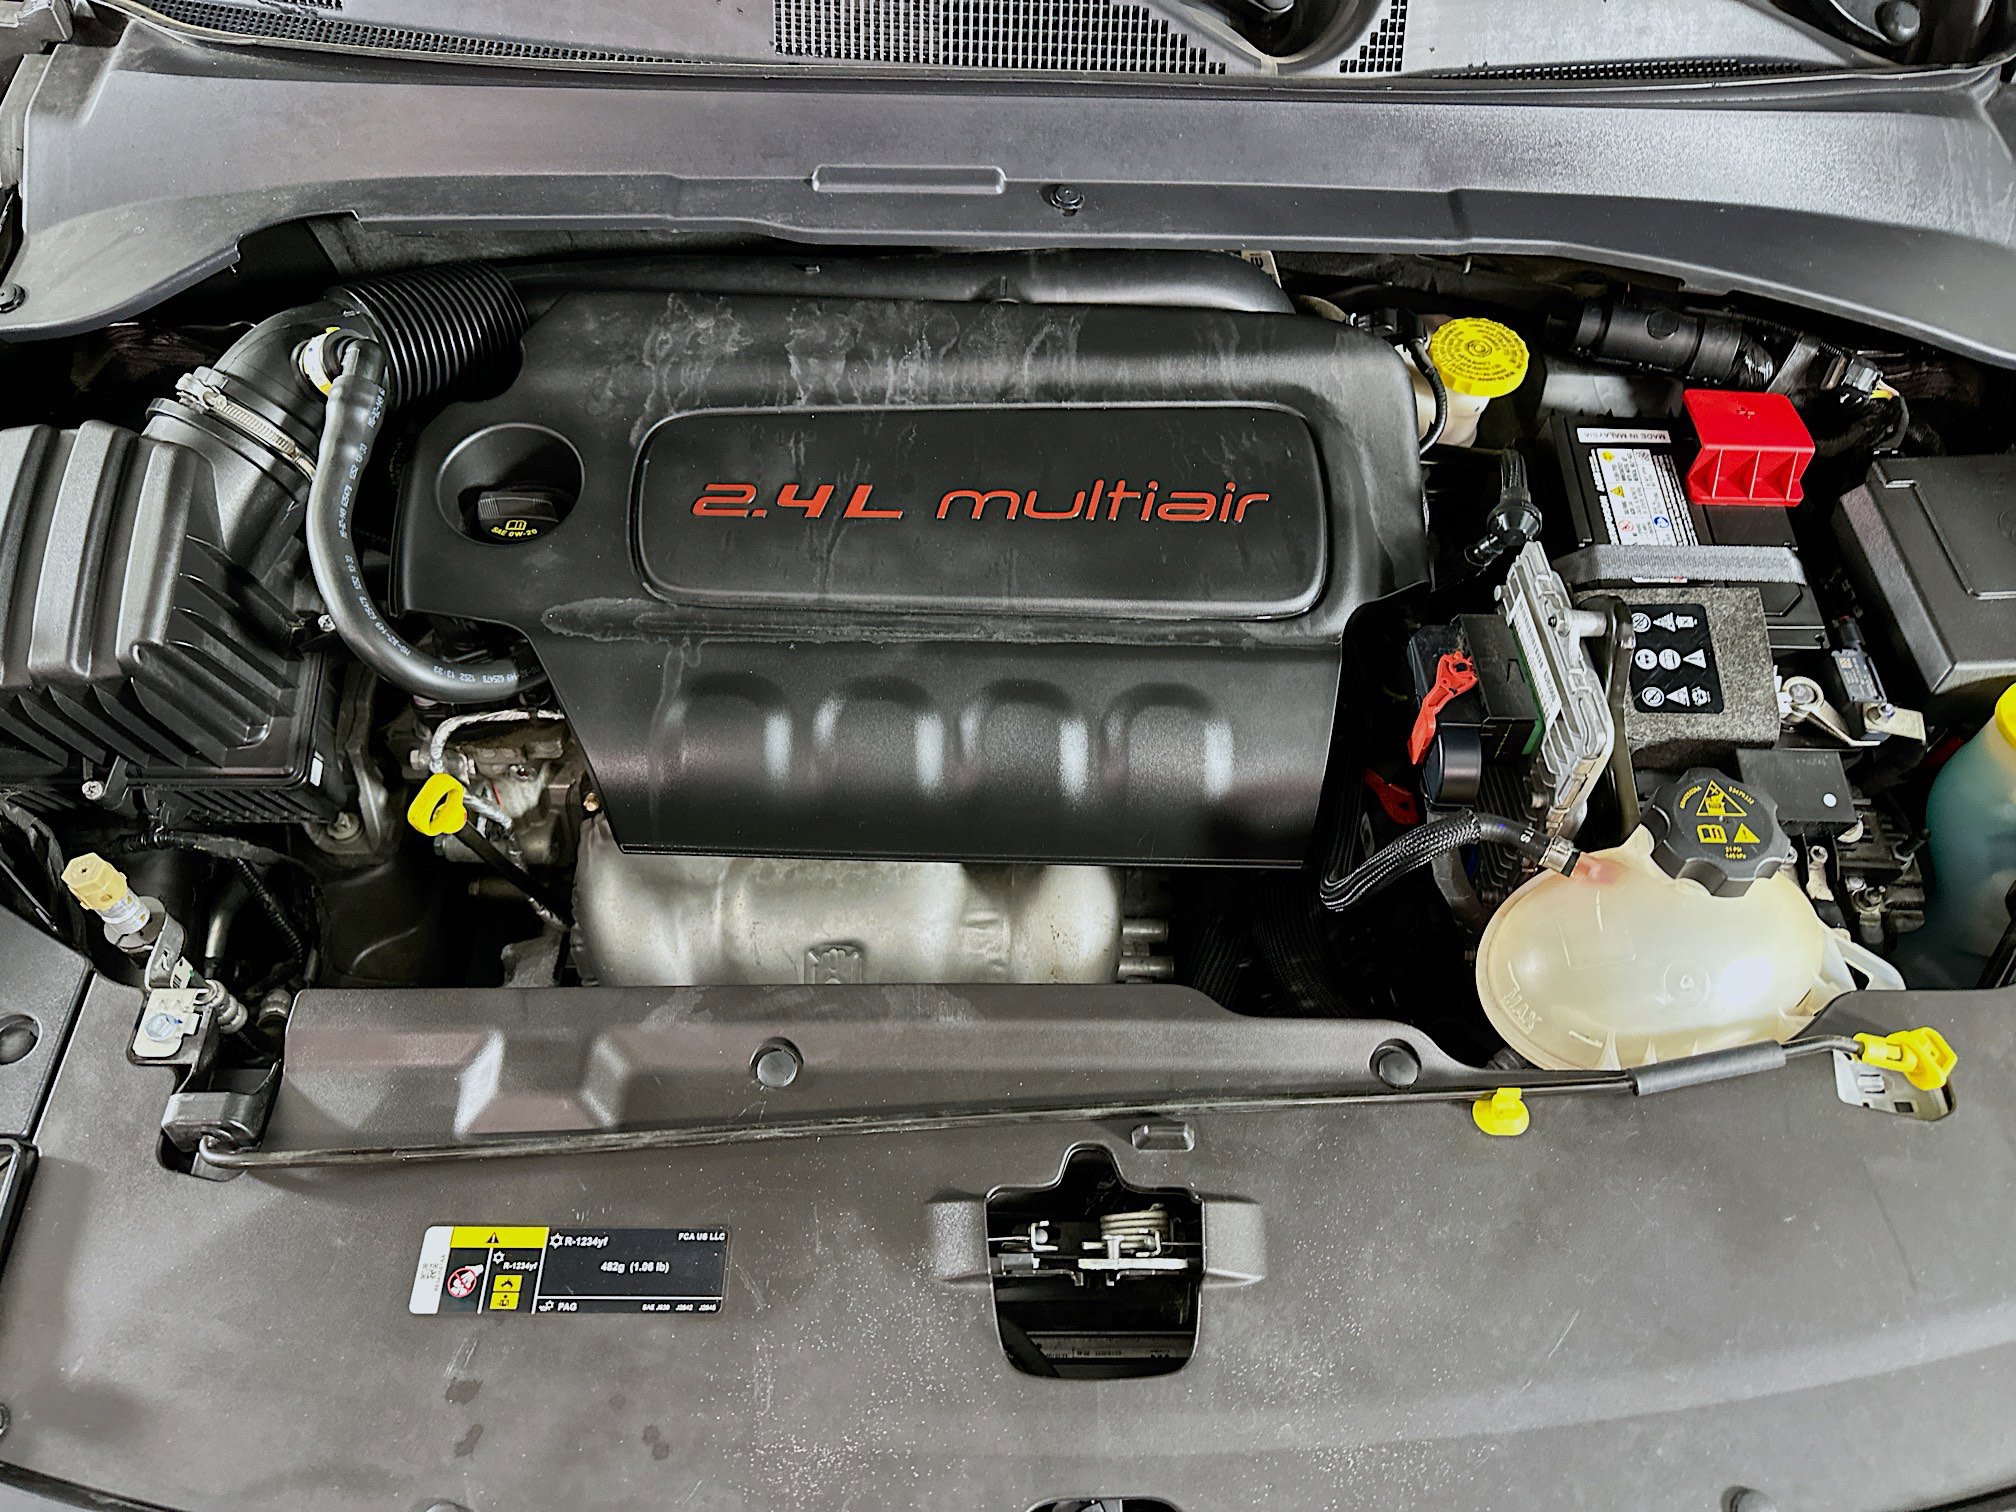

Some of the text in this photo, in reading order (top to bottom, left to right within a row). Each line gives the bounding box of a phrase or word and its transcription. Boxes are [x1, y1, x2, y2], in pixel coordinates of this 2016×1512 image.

[936, 479, 1270, 523] multiair
[491, 526, 538, 538] SAE 0W-20
[564, 1236, 609, 1249] R-1234yf
[678, 1232, 726, 1241] FCA US LLC
[503, 1261, 539, 1272] R-1234yf
[655, 1261, 670, 1274] lb)
